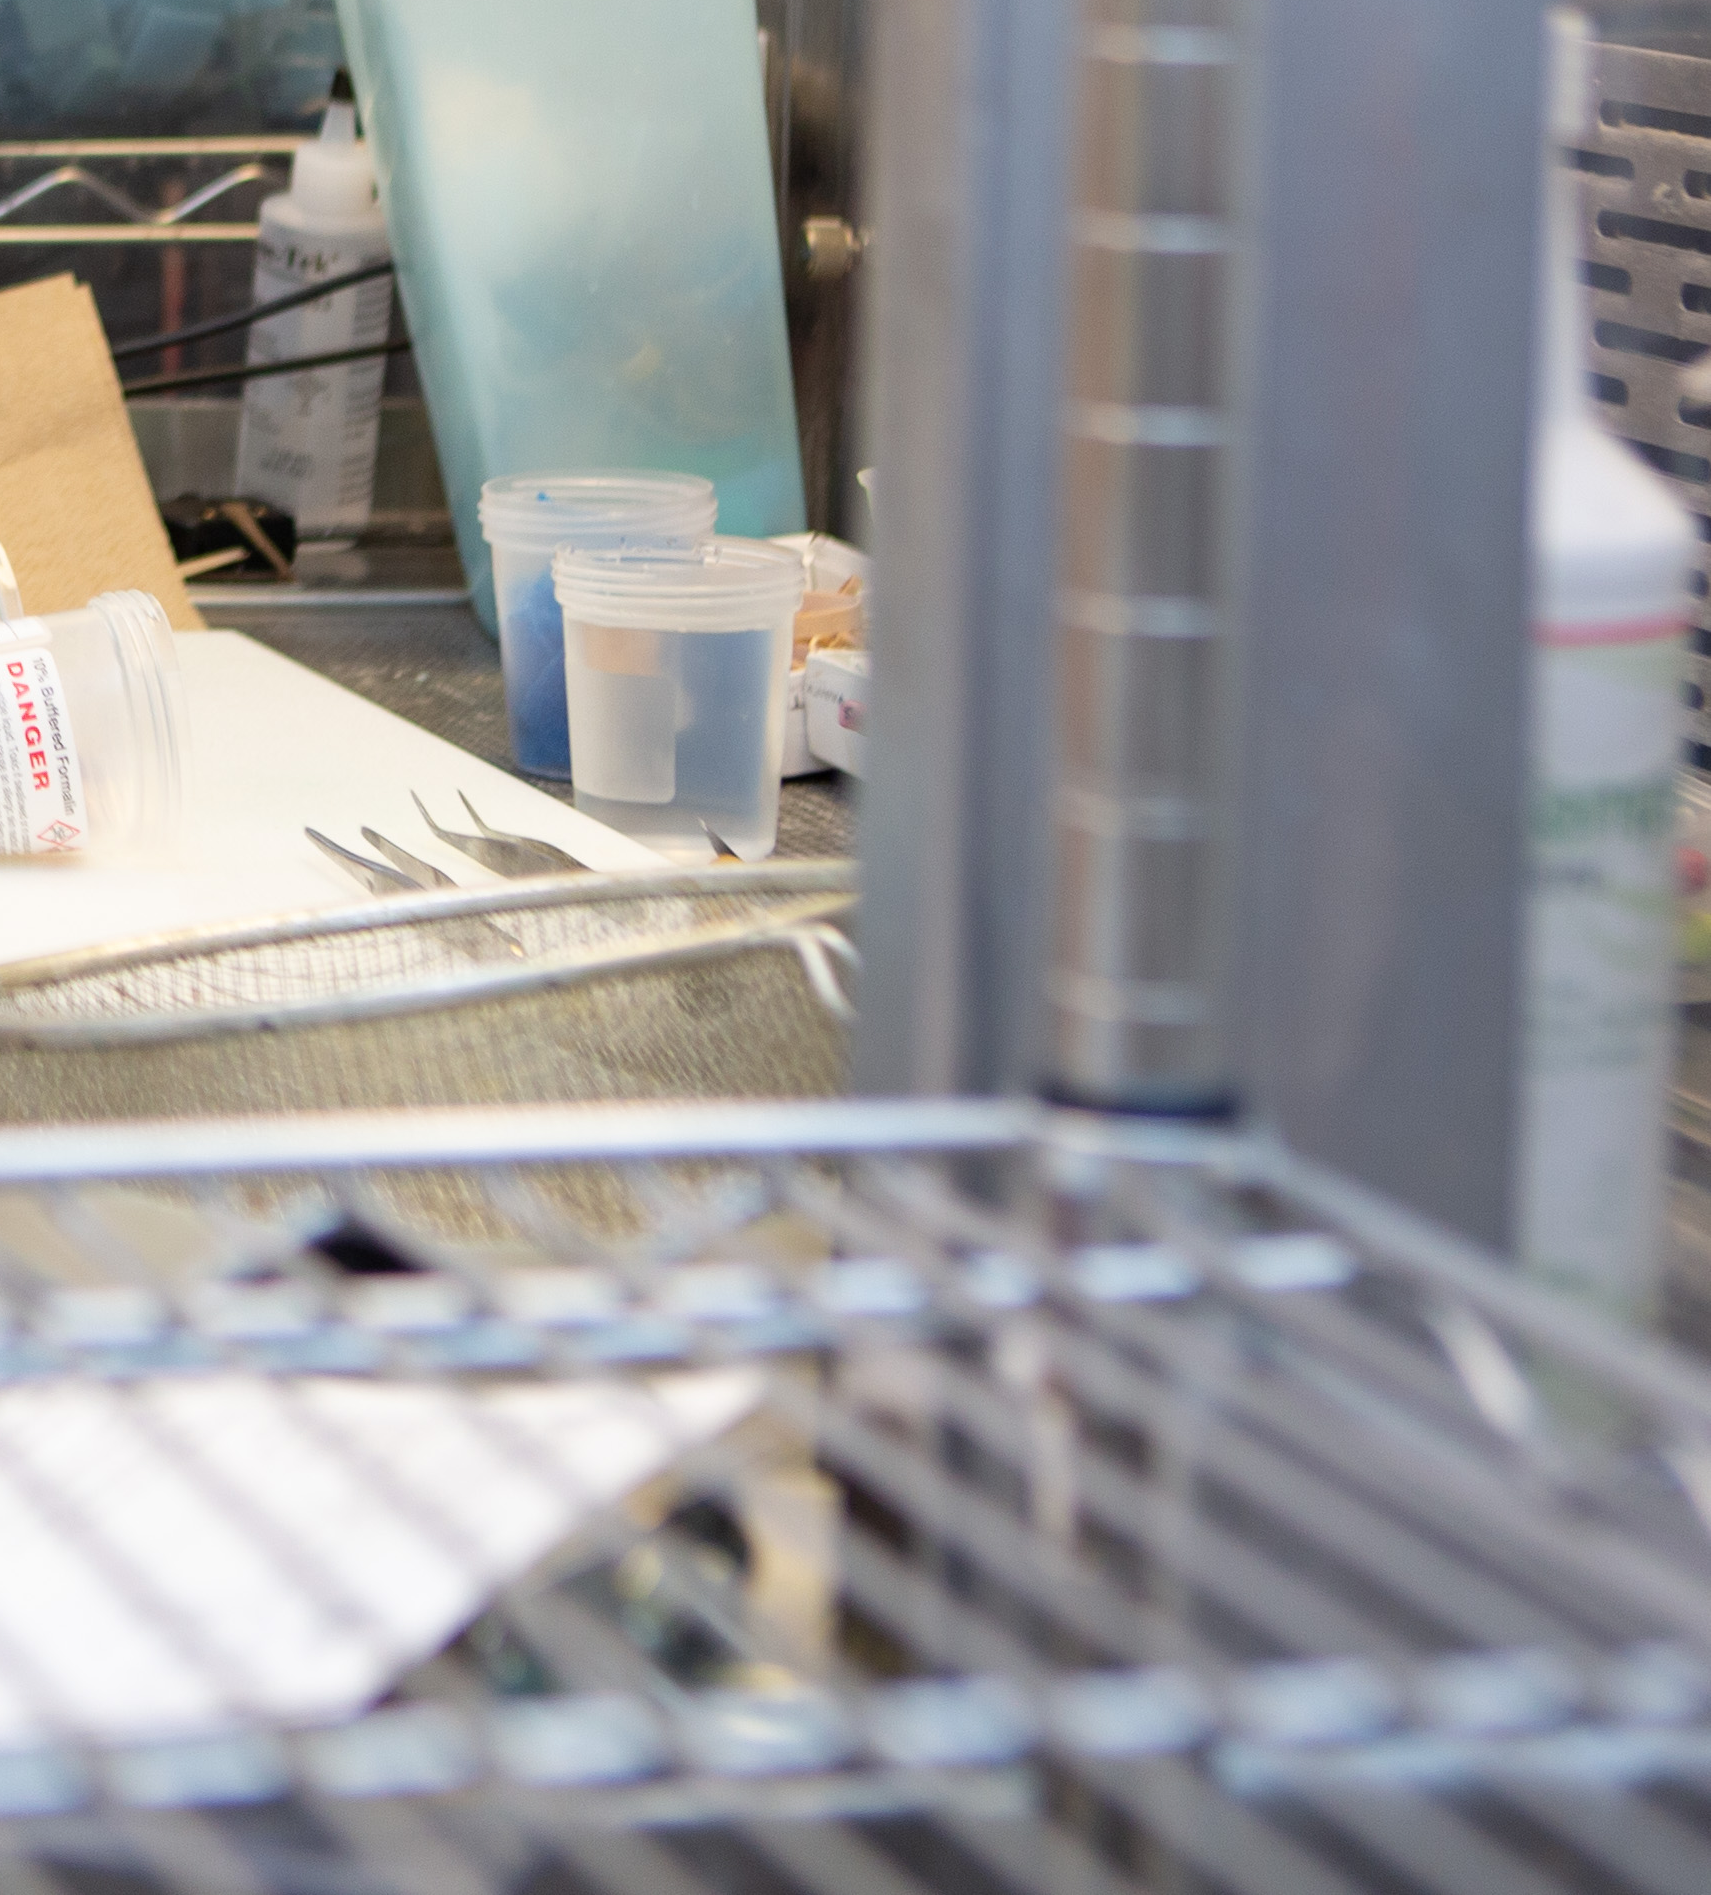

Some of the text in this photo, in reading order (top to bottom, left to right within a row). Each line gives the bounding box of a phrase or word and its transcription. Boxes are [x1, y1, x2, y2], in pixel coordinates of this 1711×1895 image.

[6, 661, 50, 791] DANGER
[32, 657, 77, 816] 10% Buffered Formalin
